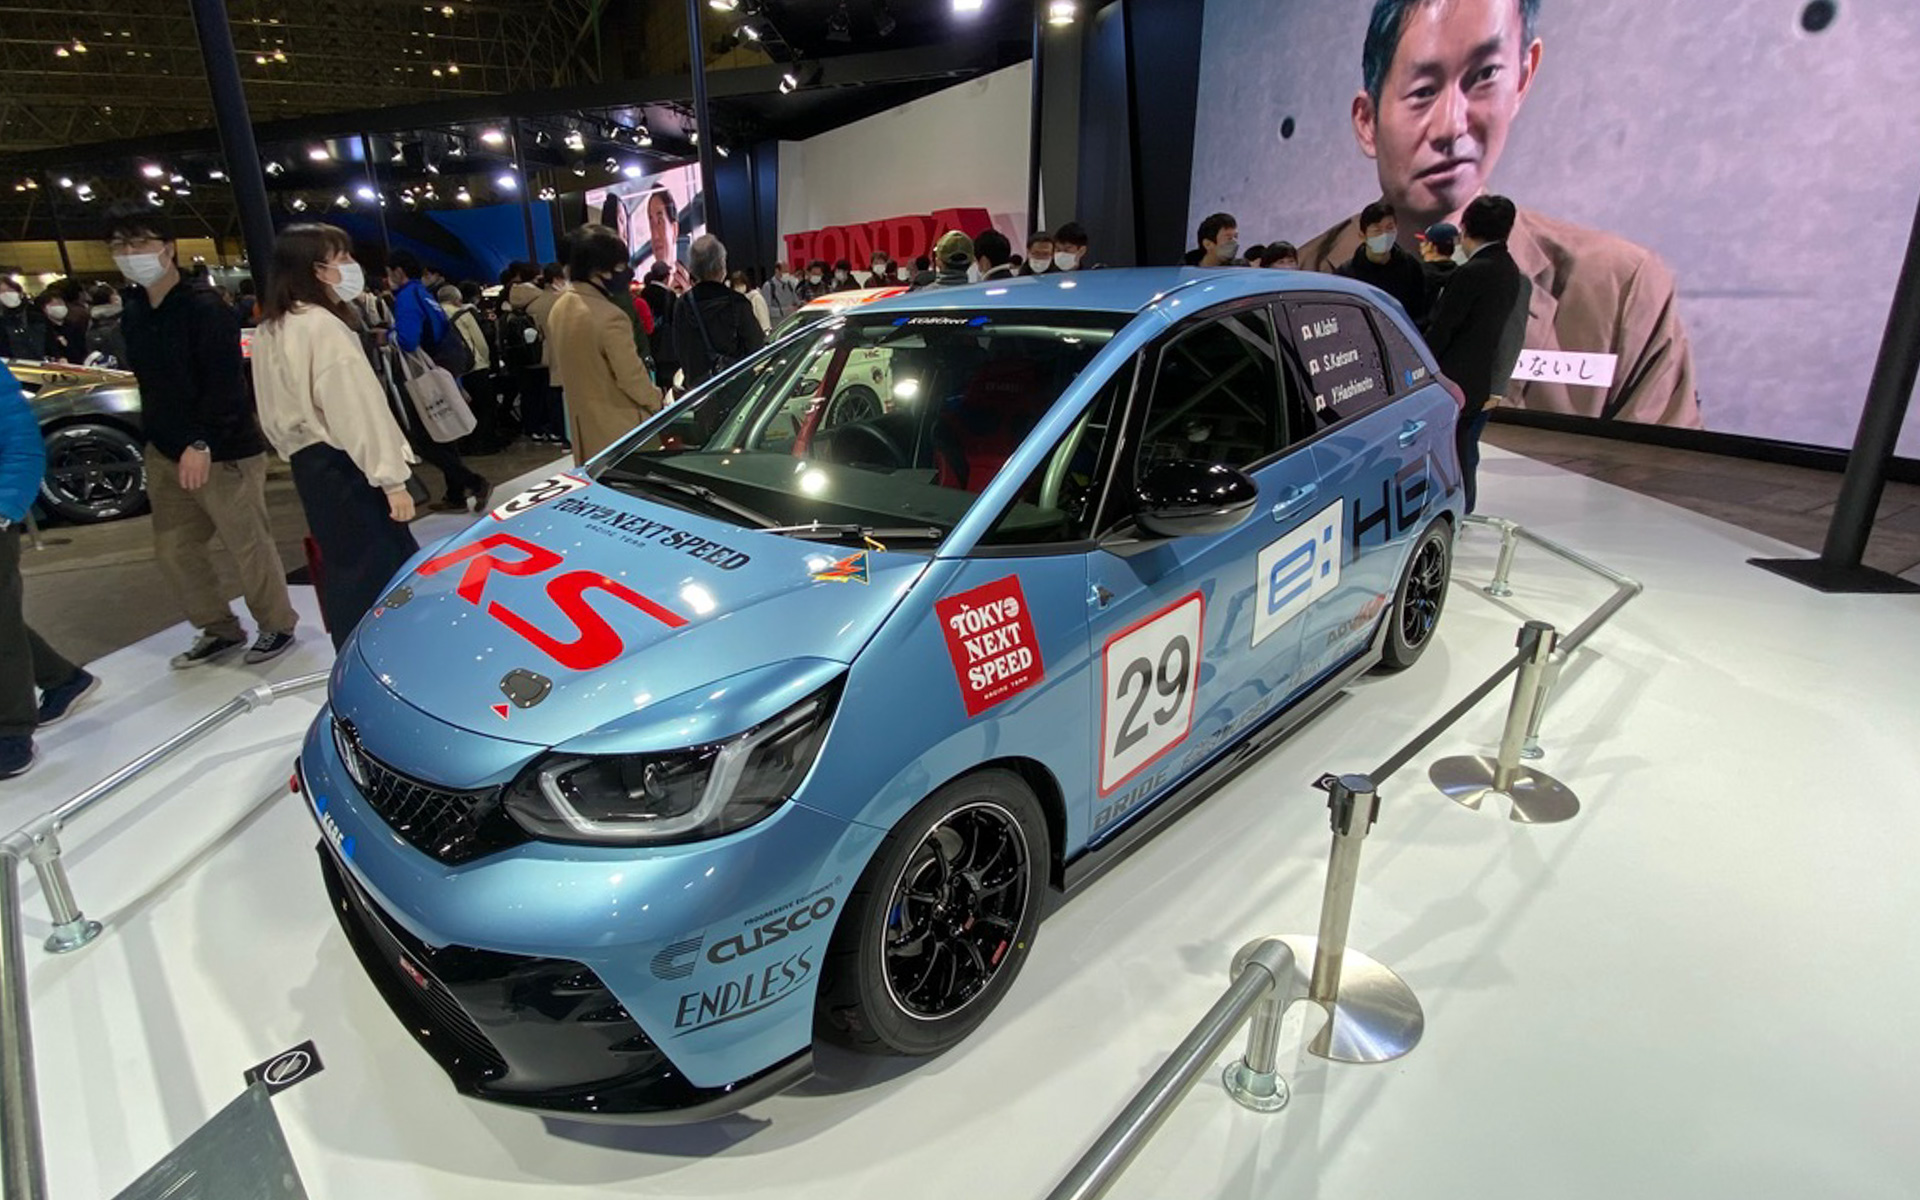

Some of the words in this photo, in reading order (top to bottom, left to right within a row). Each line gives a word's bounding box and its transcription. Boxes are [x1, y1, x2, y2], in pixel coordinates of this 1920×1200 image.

[602, 511, 676, 539] NEXT
[660, 531, 751, 571] SPEED
[416, 532, 690, 671] RS
[950, 596, 1020, 639] TOKYO
[964, 622, 1022, 664] NEXT
[968, 646, 1033, 691] SPEED
[1113, 634, 1191, 758] 29
[1093, 771, 1166, 832] BRIDE
[707, 896, 836, 964] CUSCO
[674, 946, 813, 1028] ENDLESS
